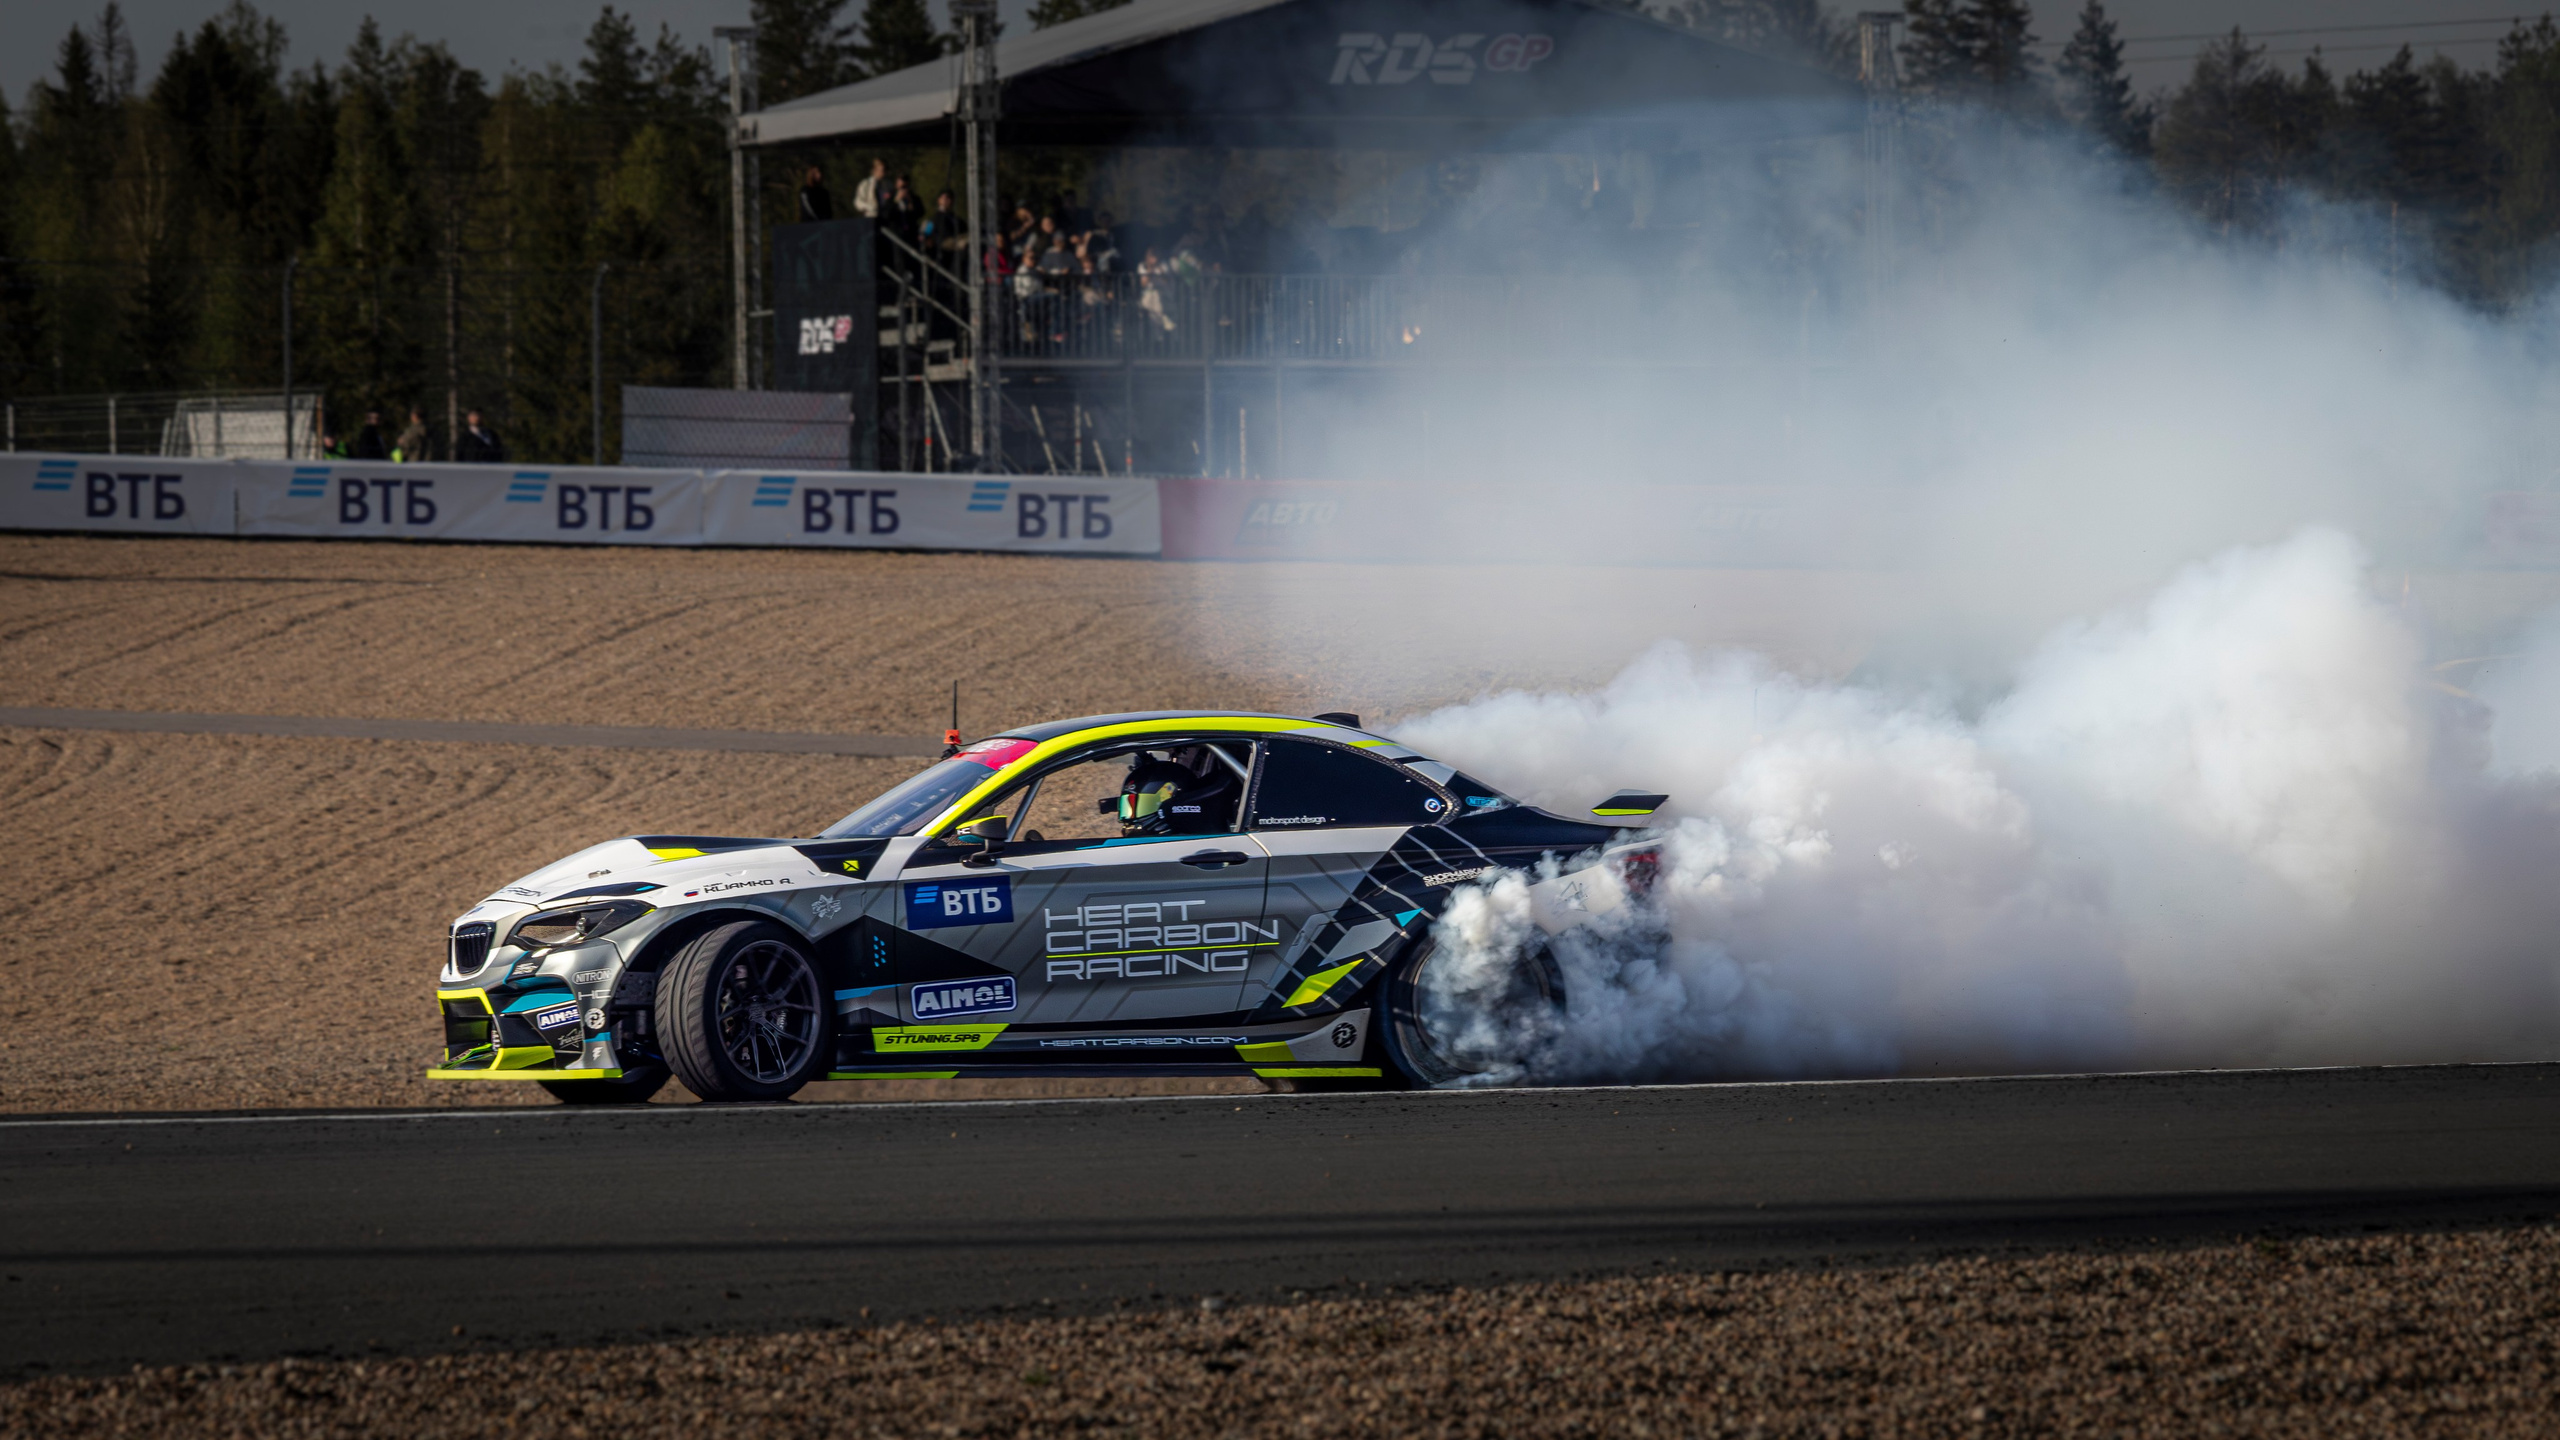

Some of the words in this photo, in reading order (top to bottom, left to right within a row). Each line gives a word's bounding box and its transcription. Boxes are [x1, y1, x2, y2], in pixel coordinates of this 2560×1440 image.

[1329, 33, 1487, 85] RDS
[1483, 32, 1554, 72] GP
[86, 471, 186, 520] ВТБ
[338, 478, 438, 525] ВТБ
[557, 485, 655, 532] ВТБ
[803, 488, 900, 534] ВТБ
[1017, 494, 1113, 540] ВТБ
[1258, 817, 1301, 826] motorsport
[1300, 815, 1327, 825] design
[704, 879, 774, 894] KLIAMKO
[942, 886, 1003, 916] ВТБ
[1044, 899, 1206, 929] HEAT
[1046, 919, 1279, 953] CARBON
[1046, 950, 1249, 982] RACING
[884, 1033, 981, 1044] STTUNING.SPB
[1040, 1036, 1248, 1047] HEATCARBON.COM
